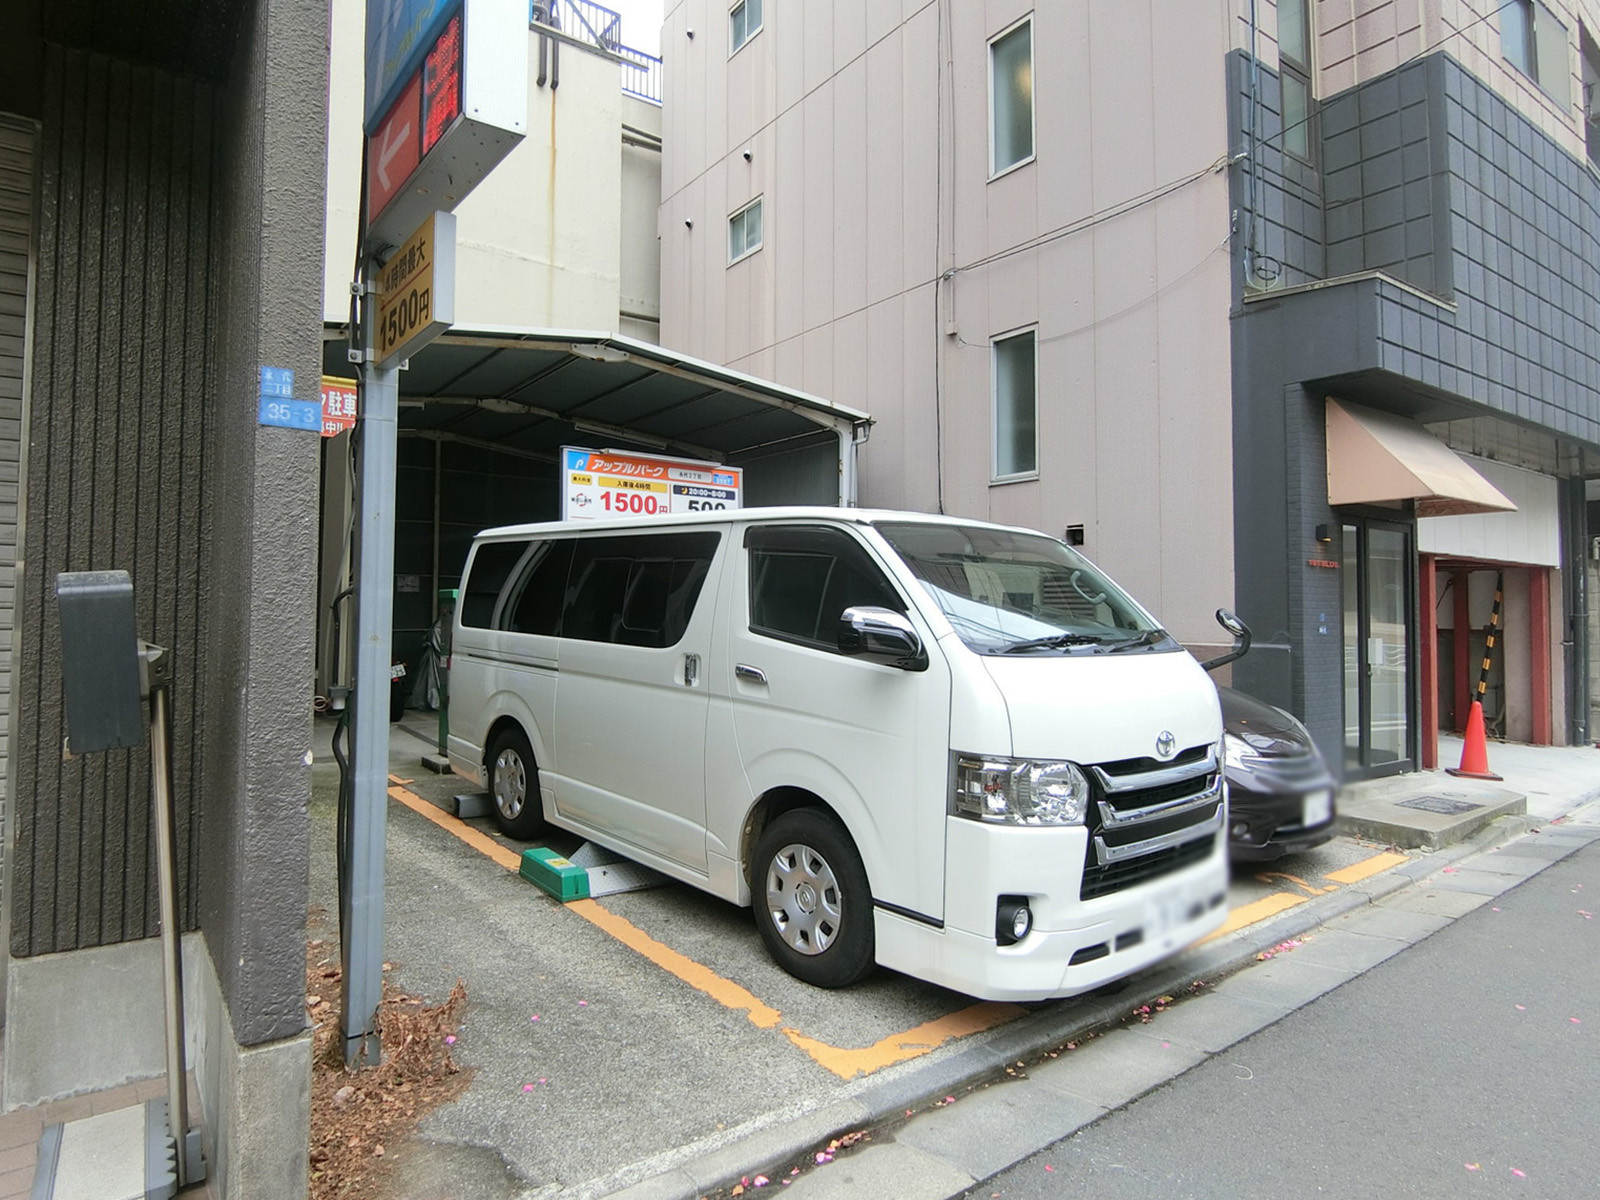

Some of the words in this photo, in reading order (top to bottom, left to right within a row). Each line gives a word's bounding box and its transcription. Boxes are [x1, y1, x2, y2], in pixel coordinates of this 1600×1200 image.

[384, 237, 426, 293] 4時間最大
[380, 288, 430, 352] 1500円
[268, 403, 315, 423] 35-3
[591, 459, 664, 477] アップルパーク
[600, 491, 668, 515] 1500円
